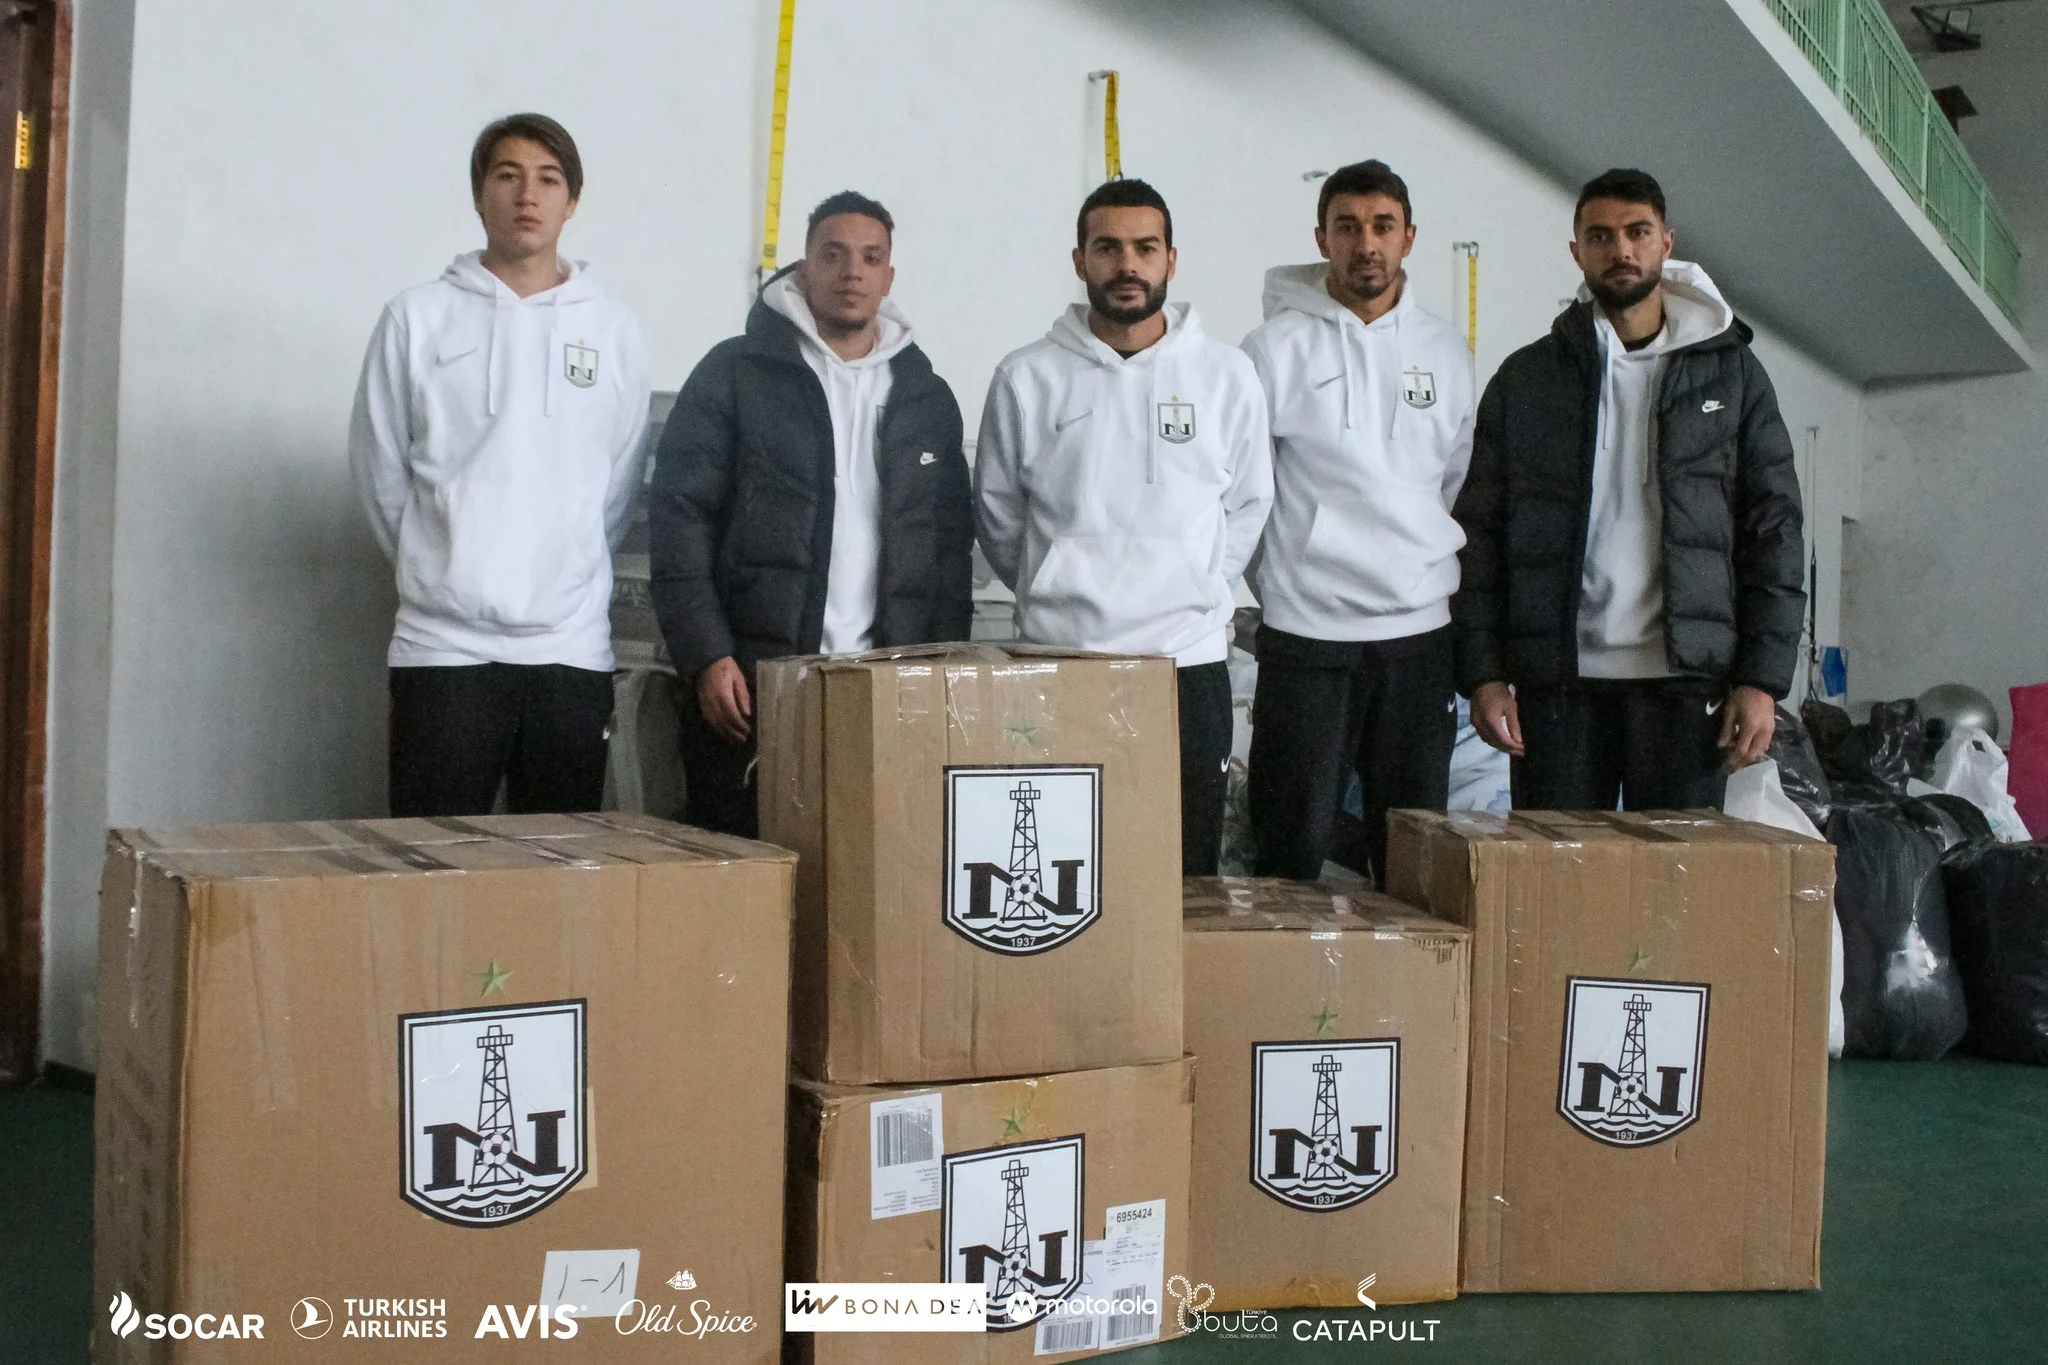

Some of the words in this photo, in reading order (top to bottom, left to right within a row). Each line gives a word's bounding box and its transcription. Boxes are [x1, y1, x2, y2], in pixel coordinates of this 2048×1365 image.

[1010, 937, 1037, 948] 1937
[1615, 1131, 1639, 1141] 1937
[1312, 1194, 1337, 1205] 1937
[481, 1203, 512, 1219] 1937
[1116, 1207, 1153, 1223] 6955424
